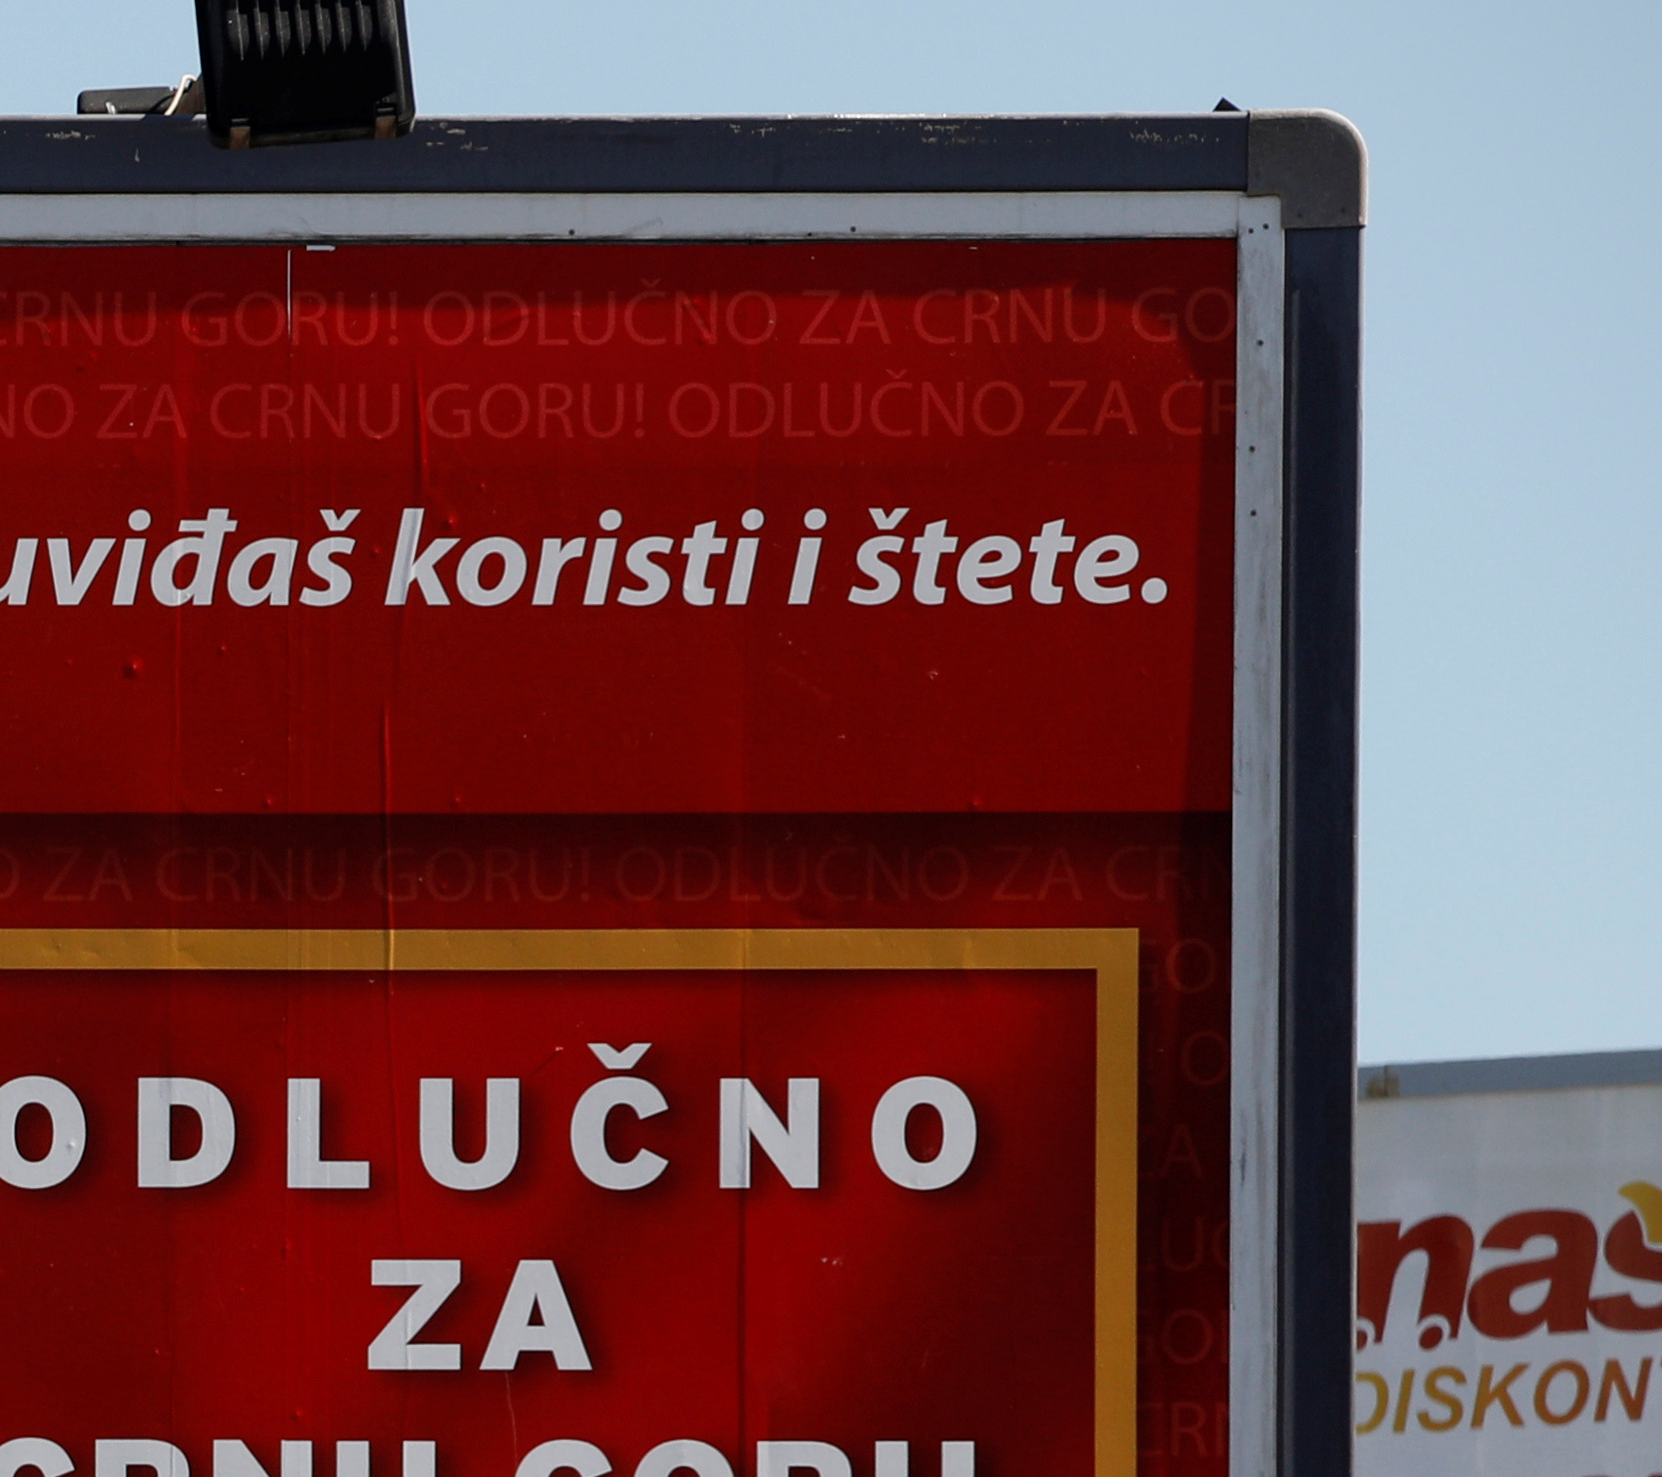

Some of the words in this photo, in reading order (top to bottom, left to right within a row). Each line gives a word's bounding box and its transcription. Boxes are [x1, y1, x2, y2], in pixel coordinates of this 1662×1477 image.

[384, 507, 765, 607] koristi
[787, 508, 827, 605] i
[848, 507, 1168, 606] štete.
[367, 1259, 592, 1371] ZA
[1356, 1356, 1662, 1435] DISKON
